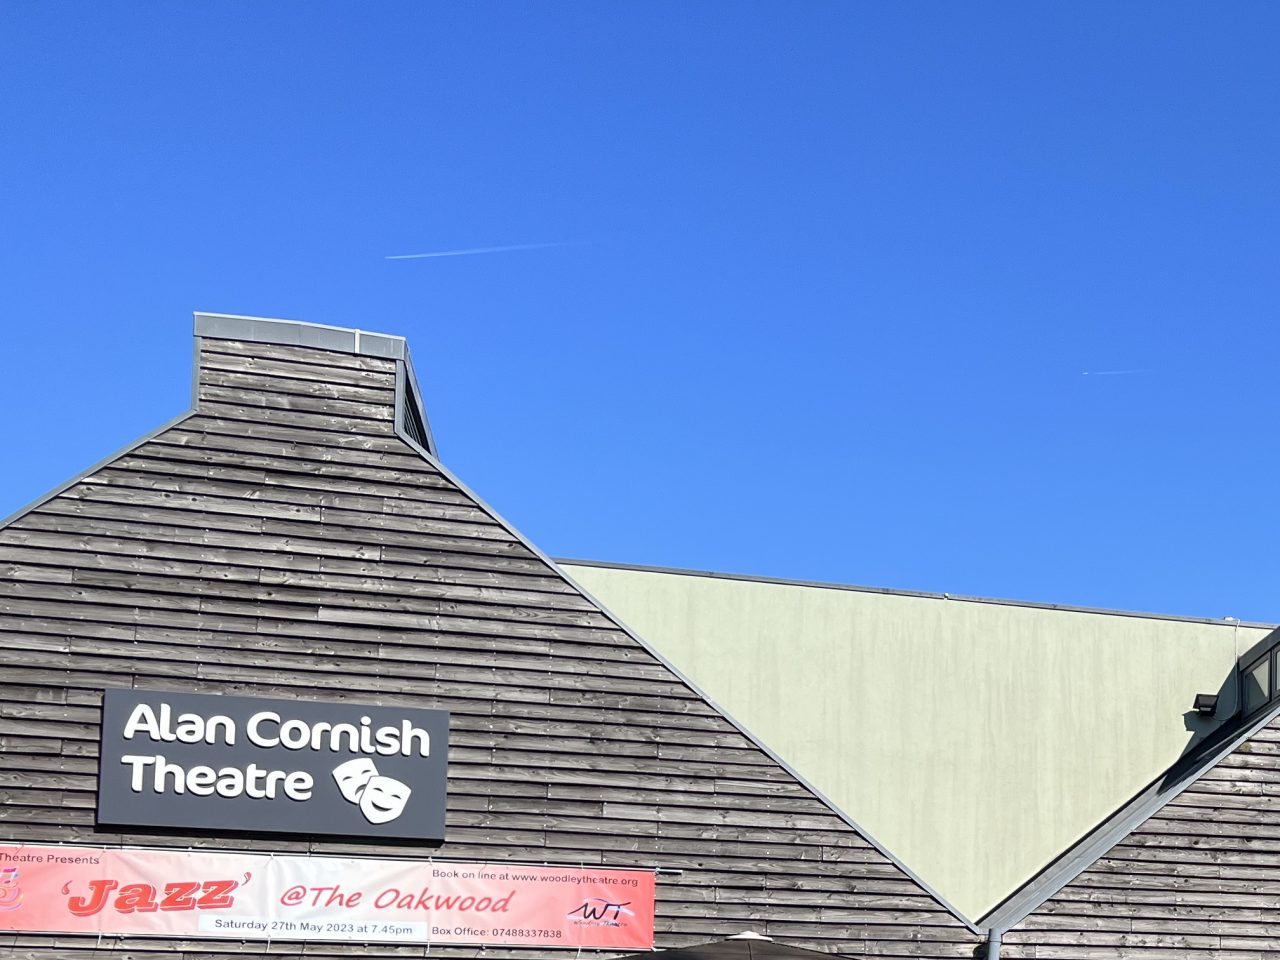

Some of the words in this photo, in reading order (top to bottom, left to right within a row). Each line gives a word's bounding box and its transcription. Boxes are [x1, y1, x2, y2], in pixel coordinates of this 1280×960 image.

[123, 703, 236, 746] Alan
[246, 711, 431, 757] Cornish
[121, 754, 314, 801] Theatre
[47, 854, 100, 865] Presents
[432, 869, 459, 879] Book
[462, 872, 475, 880] on
[499, 873, 510, 881] at
[511, 873, 639, 887] www.woodleytheatre.org
[280, 885, 362, 908] @The
[374, 887, 516, 913] Oakwood
[215, 919, 268, 932] Saturday
[271, 921, 297, 931] 27th
[300, 922, 323, 933] May
[326, 922, 354, 933] 2023
[357, 924, 369, 933] at
[372, 924, 413, 935] 7.45pm
[432, 927, 452, 935] Box
[454, 927, 490, 936] Office:
[492, 928, 562, 938] 07488337838
